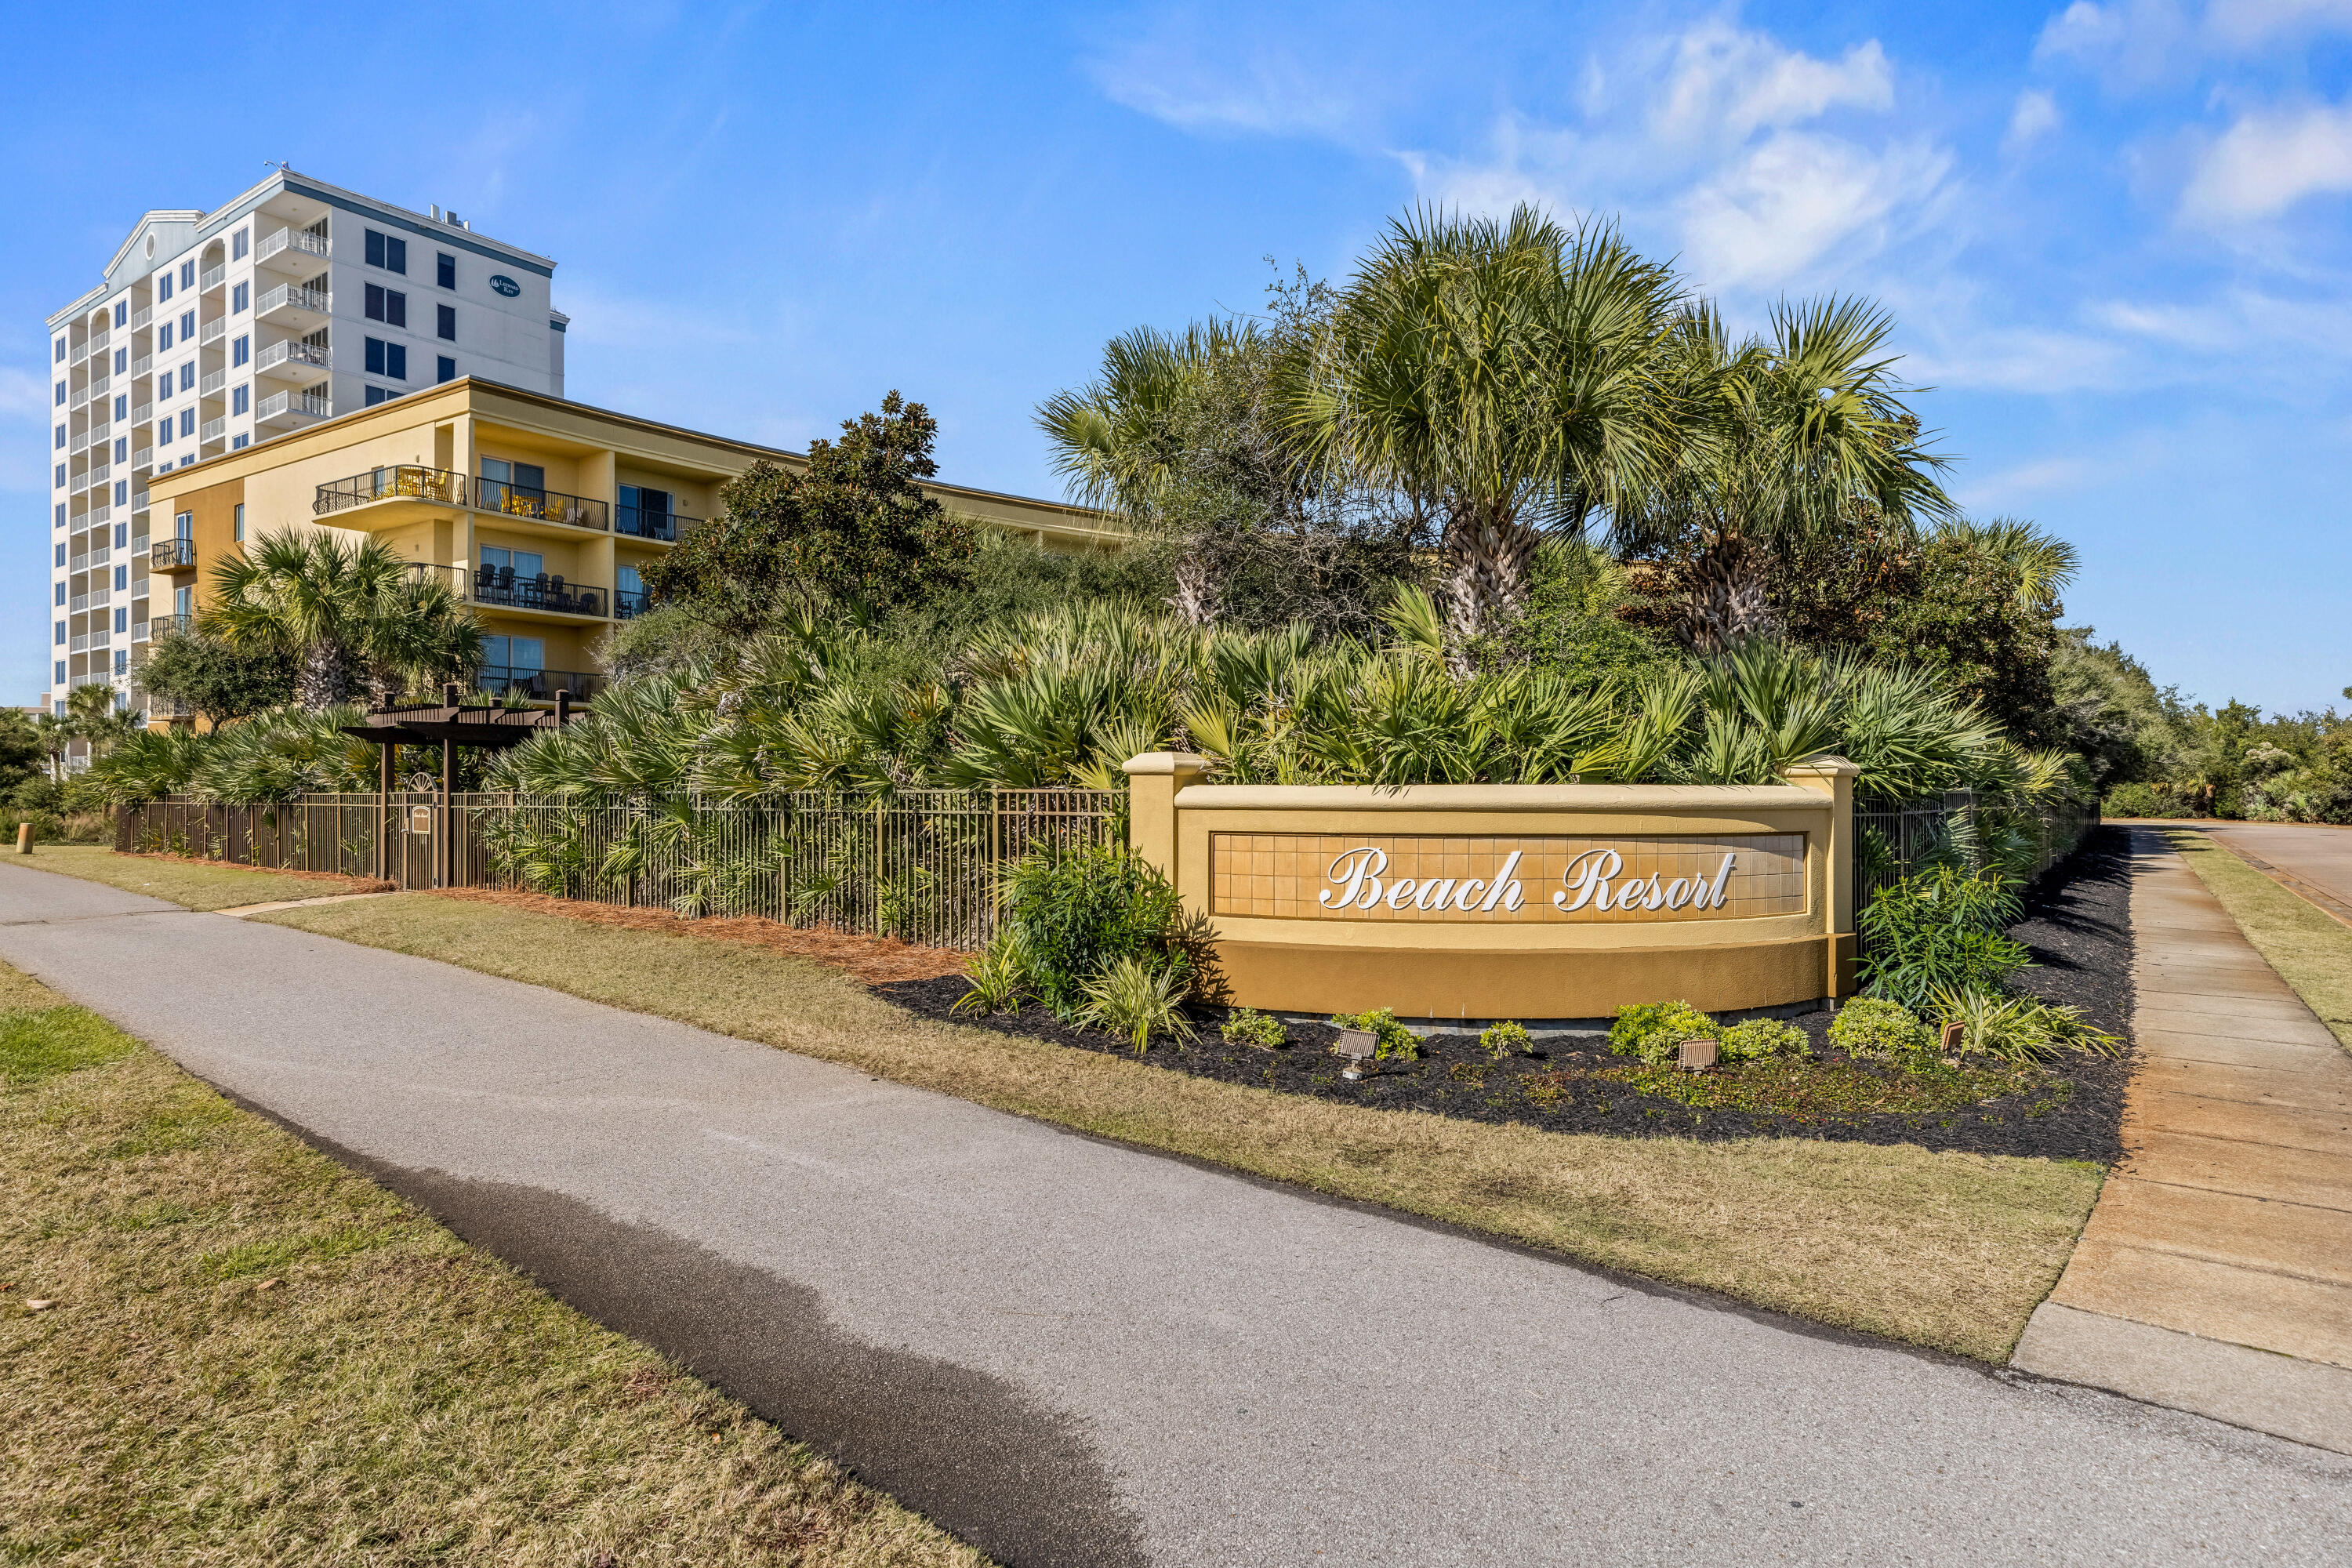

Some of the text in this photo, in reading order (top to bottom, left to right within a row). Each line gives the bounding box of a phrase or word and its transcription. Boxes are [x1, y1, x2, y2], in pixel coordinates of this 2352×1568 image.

[499, 279, 519, 291] LEEWARD
[1319, 847, 1737, 912] Beach Resort
